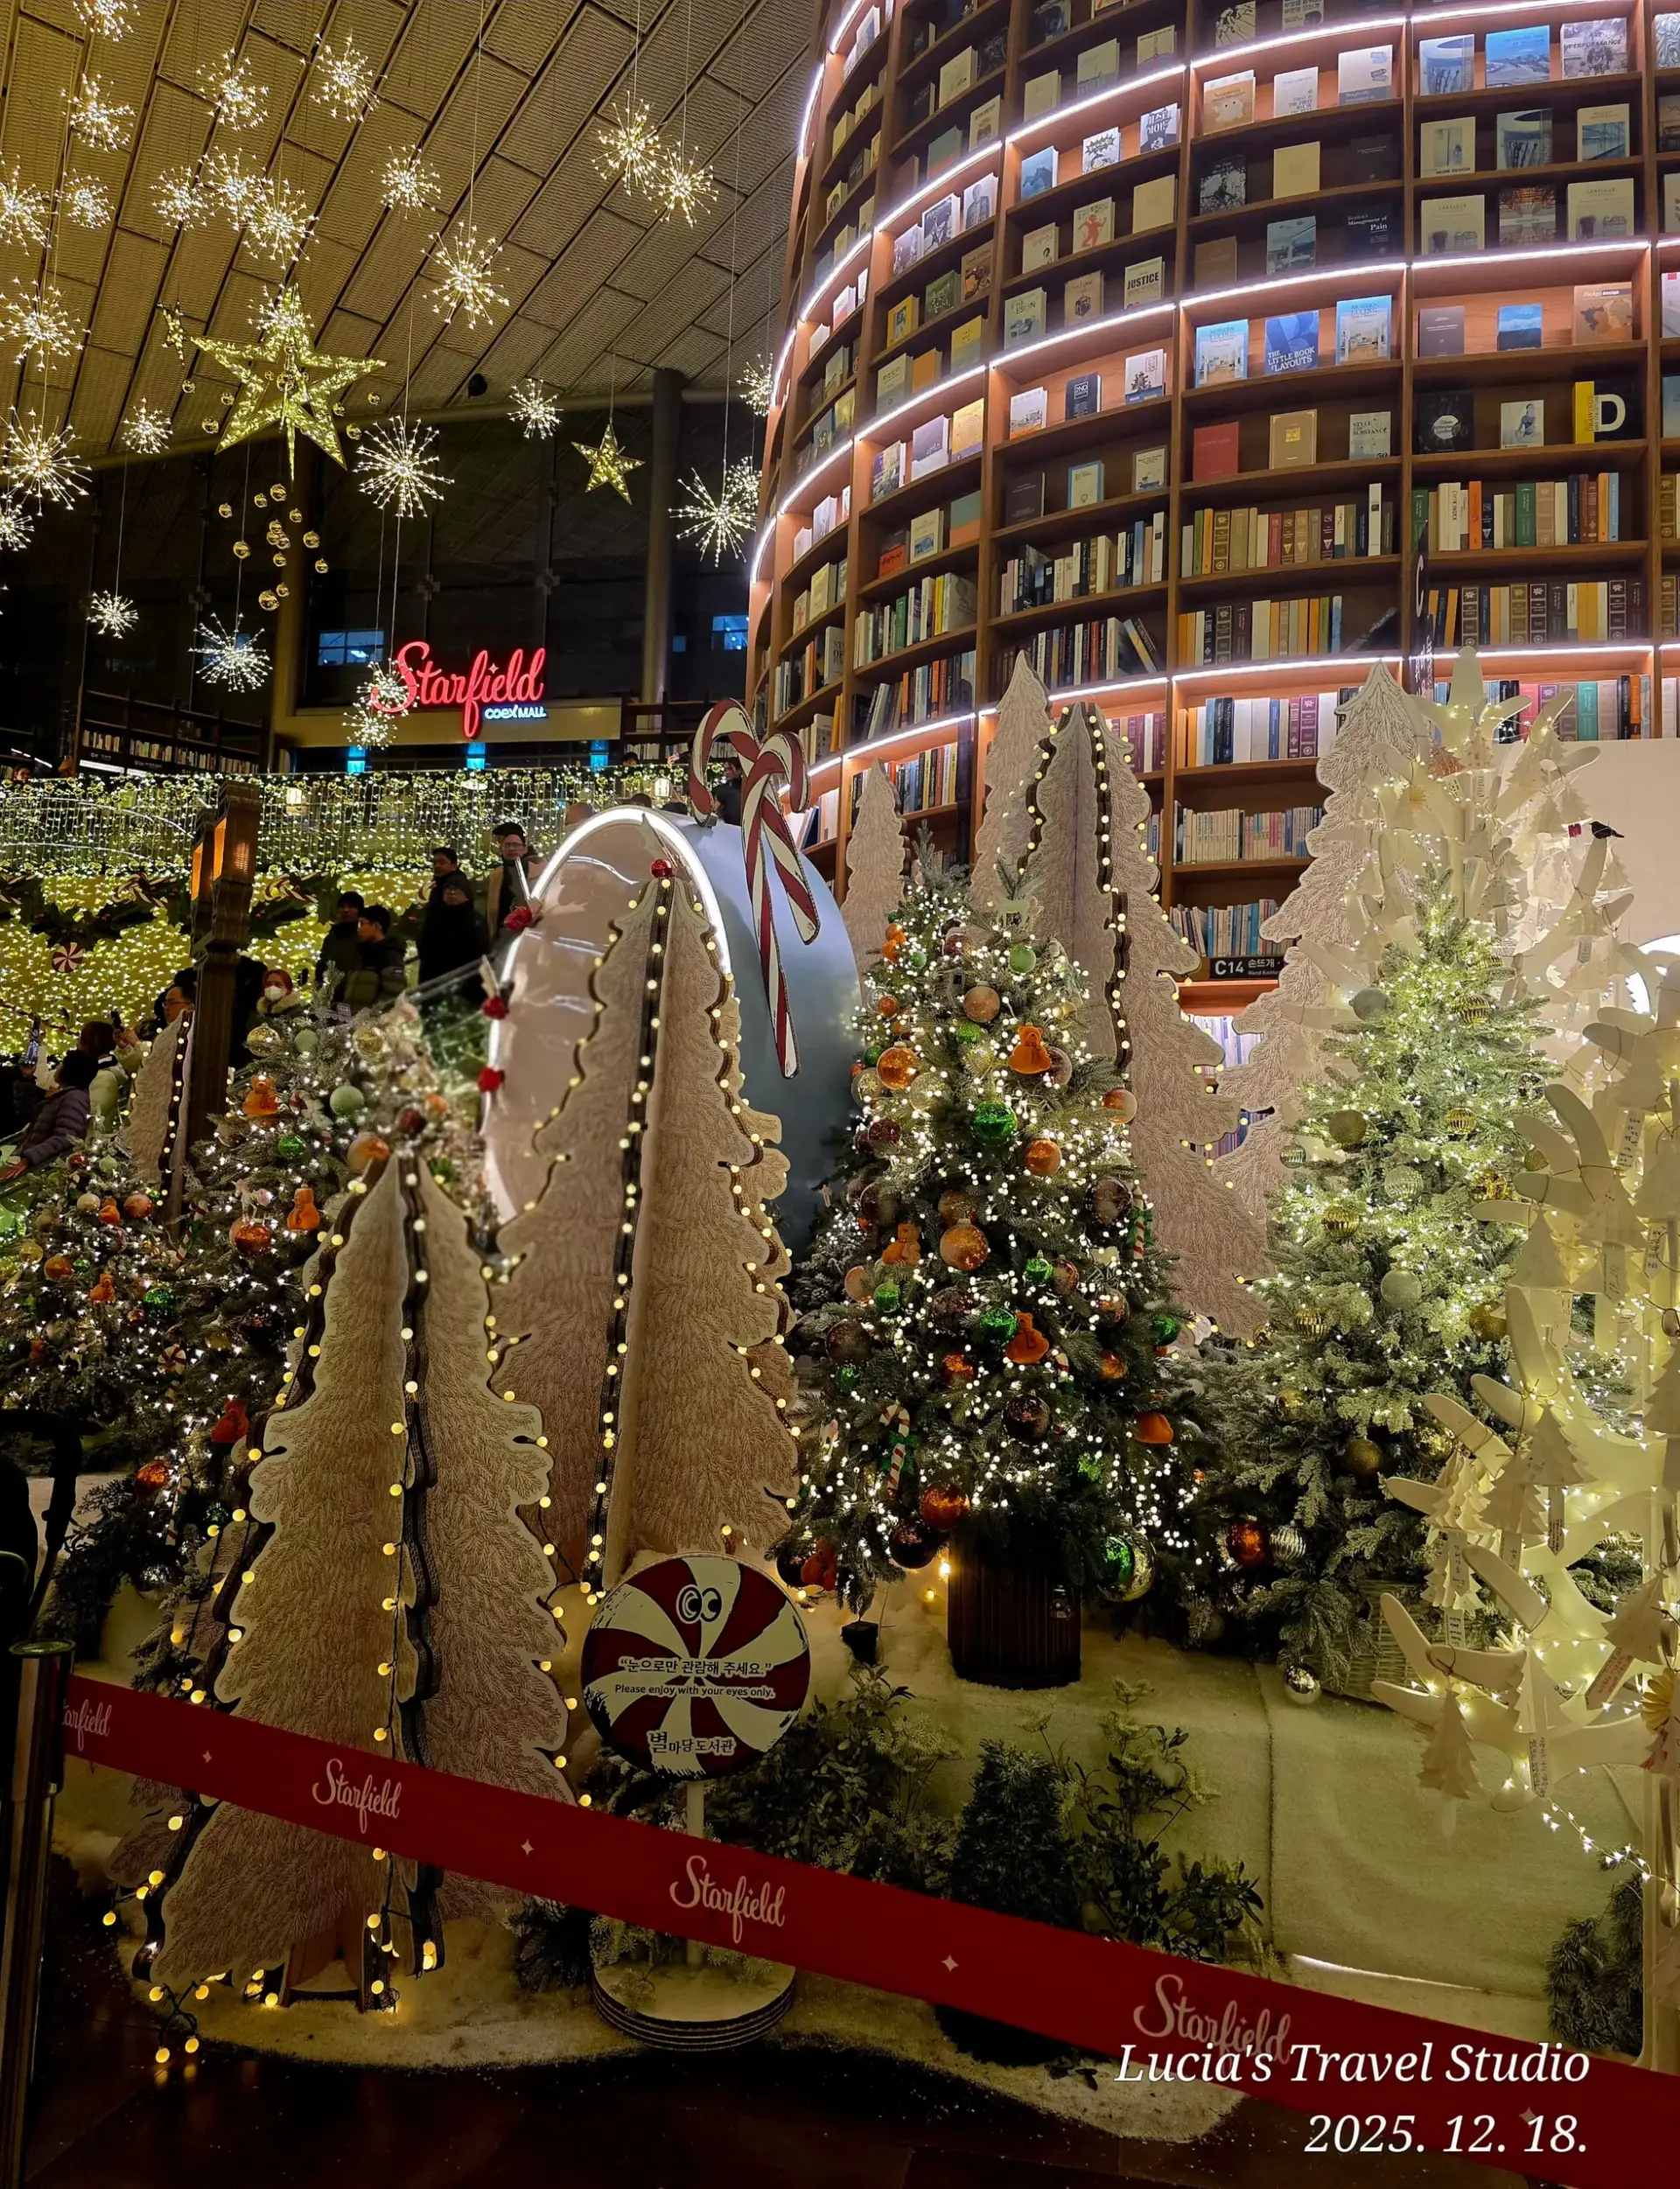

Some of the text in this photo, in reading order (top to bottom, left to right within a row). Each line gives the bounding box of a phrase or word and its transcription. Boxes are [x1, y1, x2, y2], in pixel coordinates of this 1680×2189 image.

[1127, 272, 1159, 290] JUSTICE
[1268, 350, 1281, 359] THE
[1268, 346, 1315, 366] LITTLE BOOK
[1275, 354, 1312, 372] LAYOUTS
[371, 641, 546, 738] Starfield
[518, 706, 547, 718] MALL
[1214, 960, 1244, 976] C14
[1248, 959, 1275, 969] 손뜨개
[682, 1660, 719, 1675] 관람해
[615, 1684, 774, 1698] Please enjoy with your eyes only.
[62, 1699, 112, 1752] arfield
[650, 1731, 734, 1755] 별마당 도서관
[312, 1759, 402, 1834] Starfield
[669, 1855, 786, 1944] Starfield
[1134, 1974, 1292, 2076] Starfield
